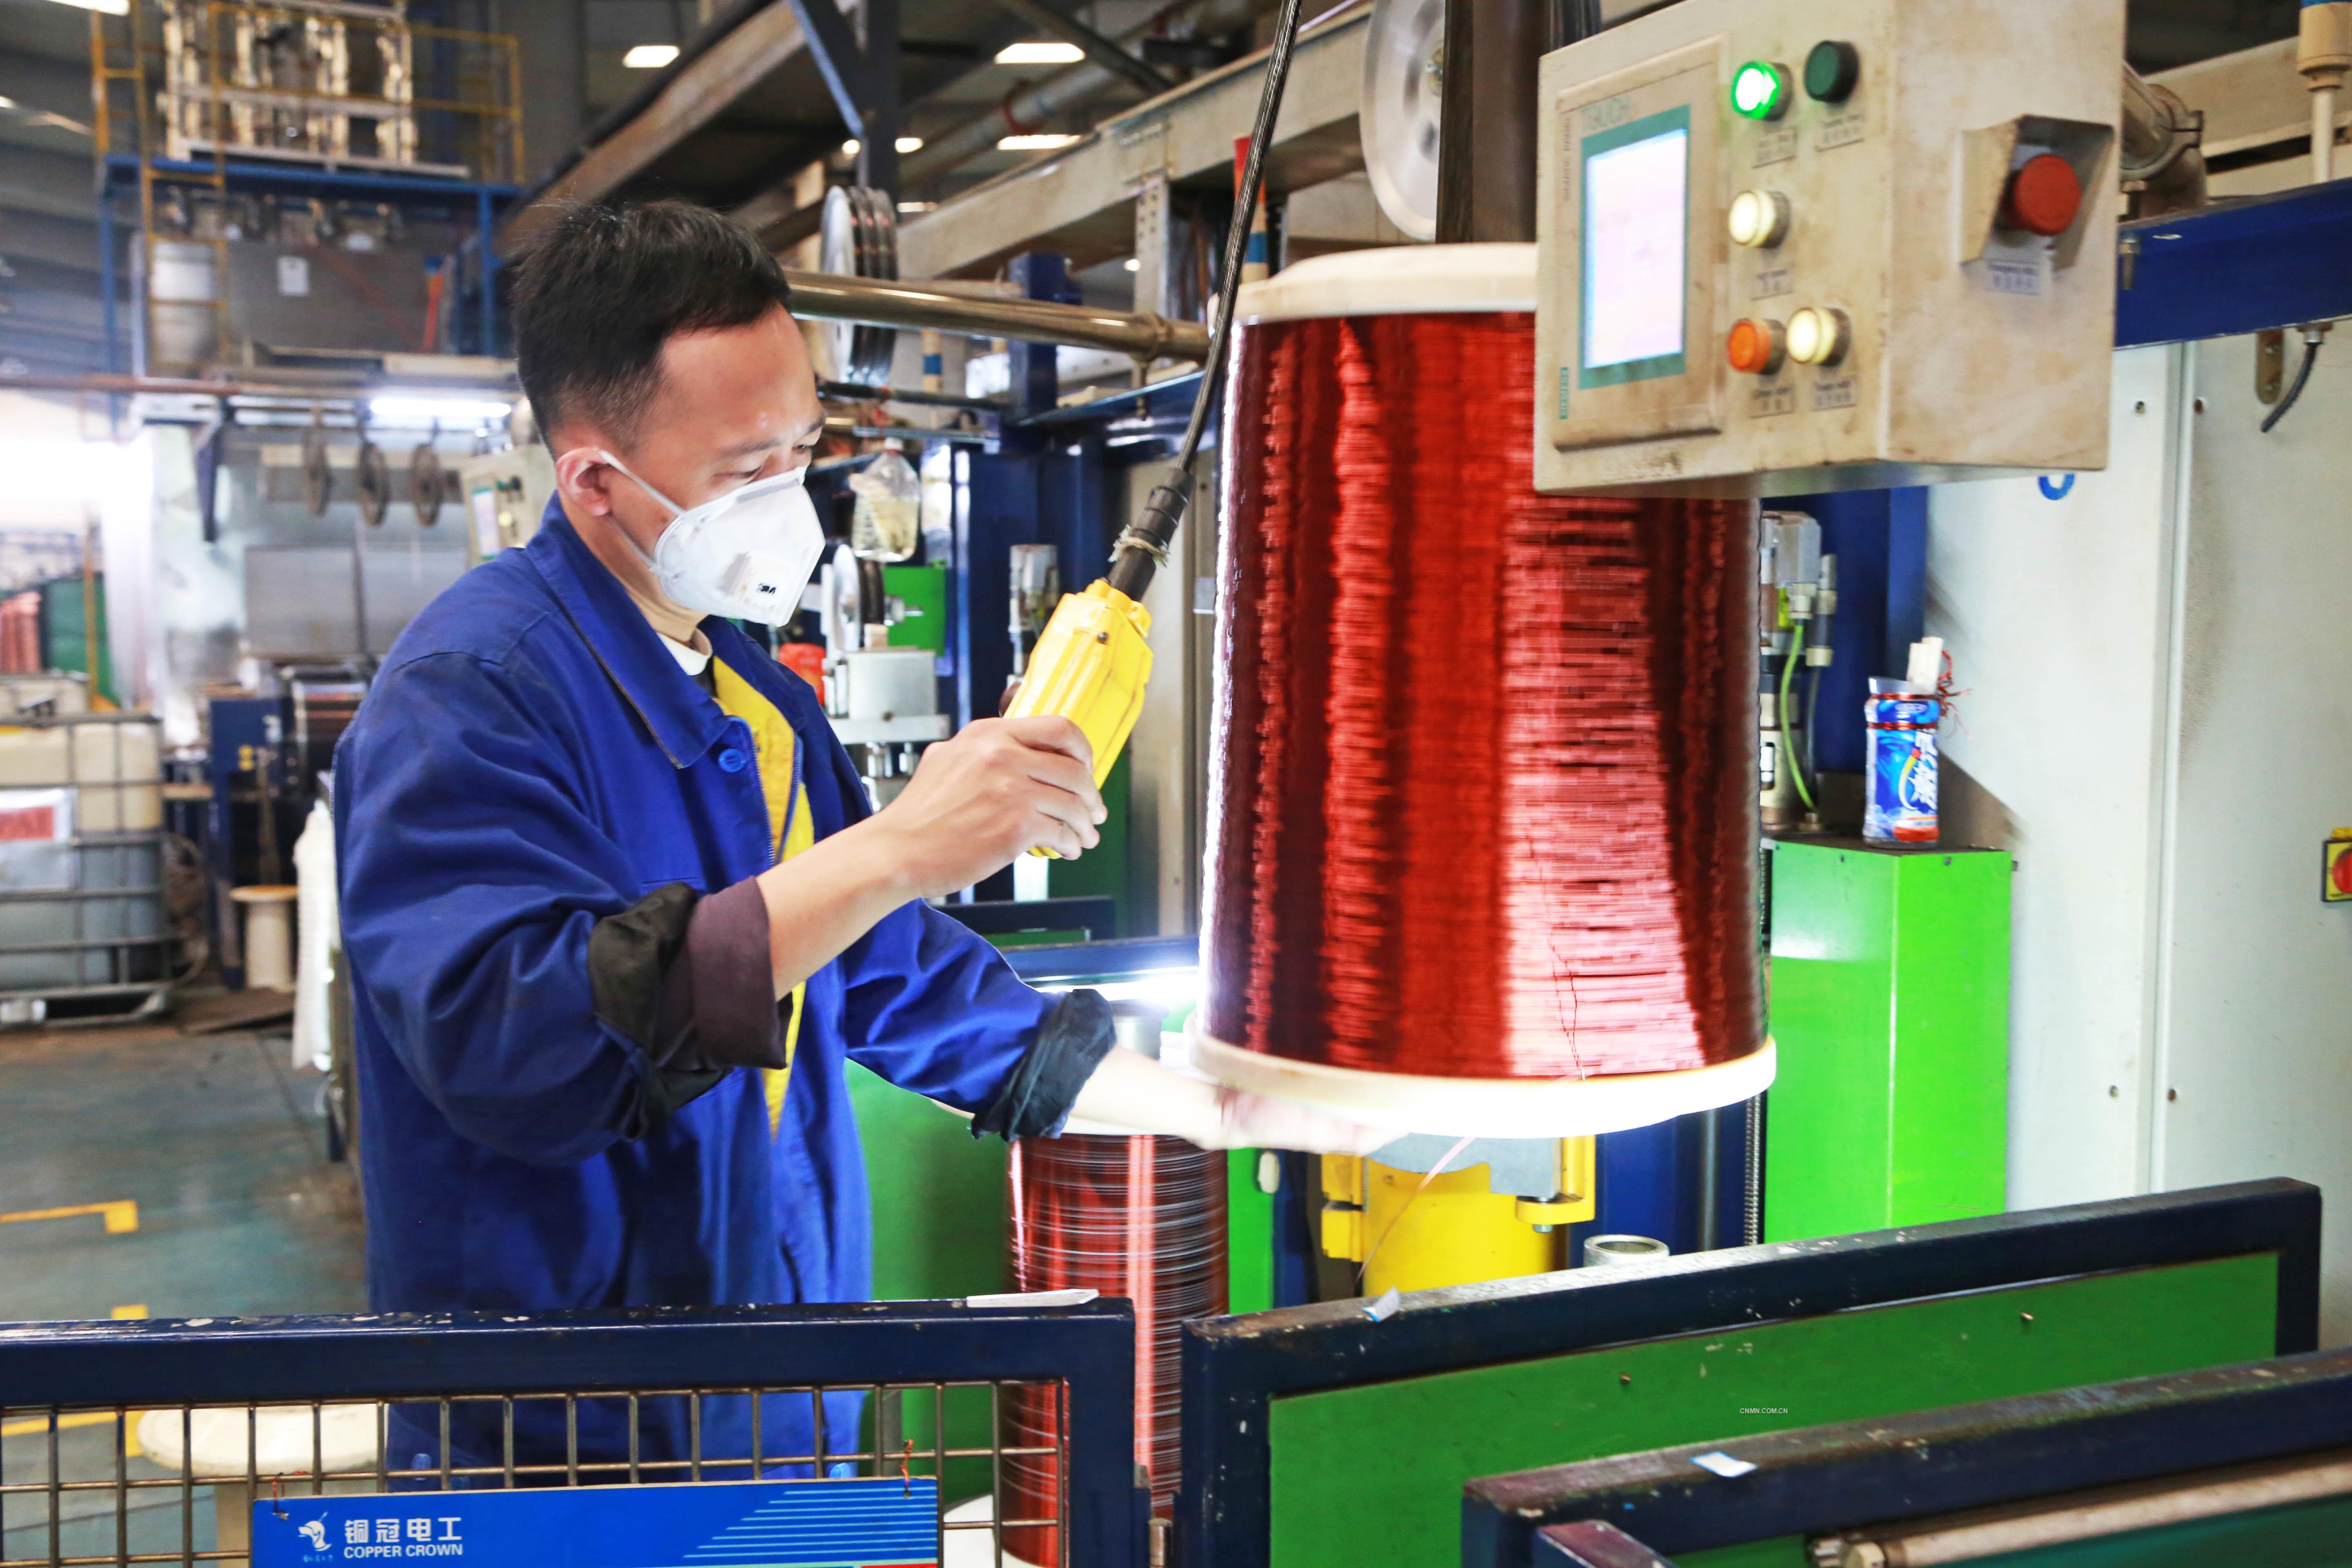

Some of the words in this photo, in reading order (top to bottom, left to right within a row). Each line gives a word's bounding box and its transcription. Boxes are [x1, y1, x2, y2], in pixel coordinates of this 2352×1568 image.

[345, 1517, 462, 1544] 铜冠电工
[344, 1545, 402, 1559] COPPER
[405, 1544, 463, 1557] CROWN
